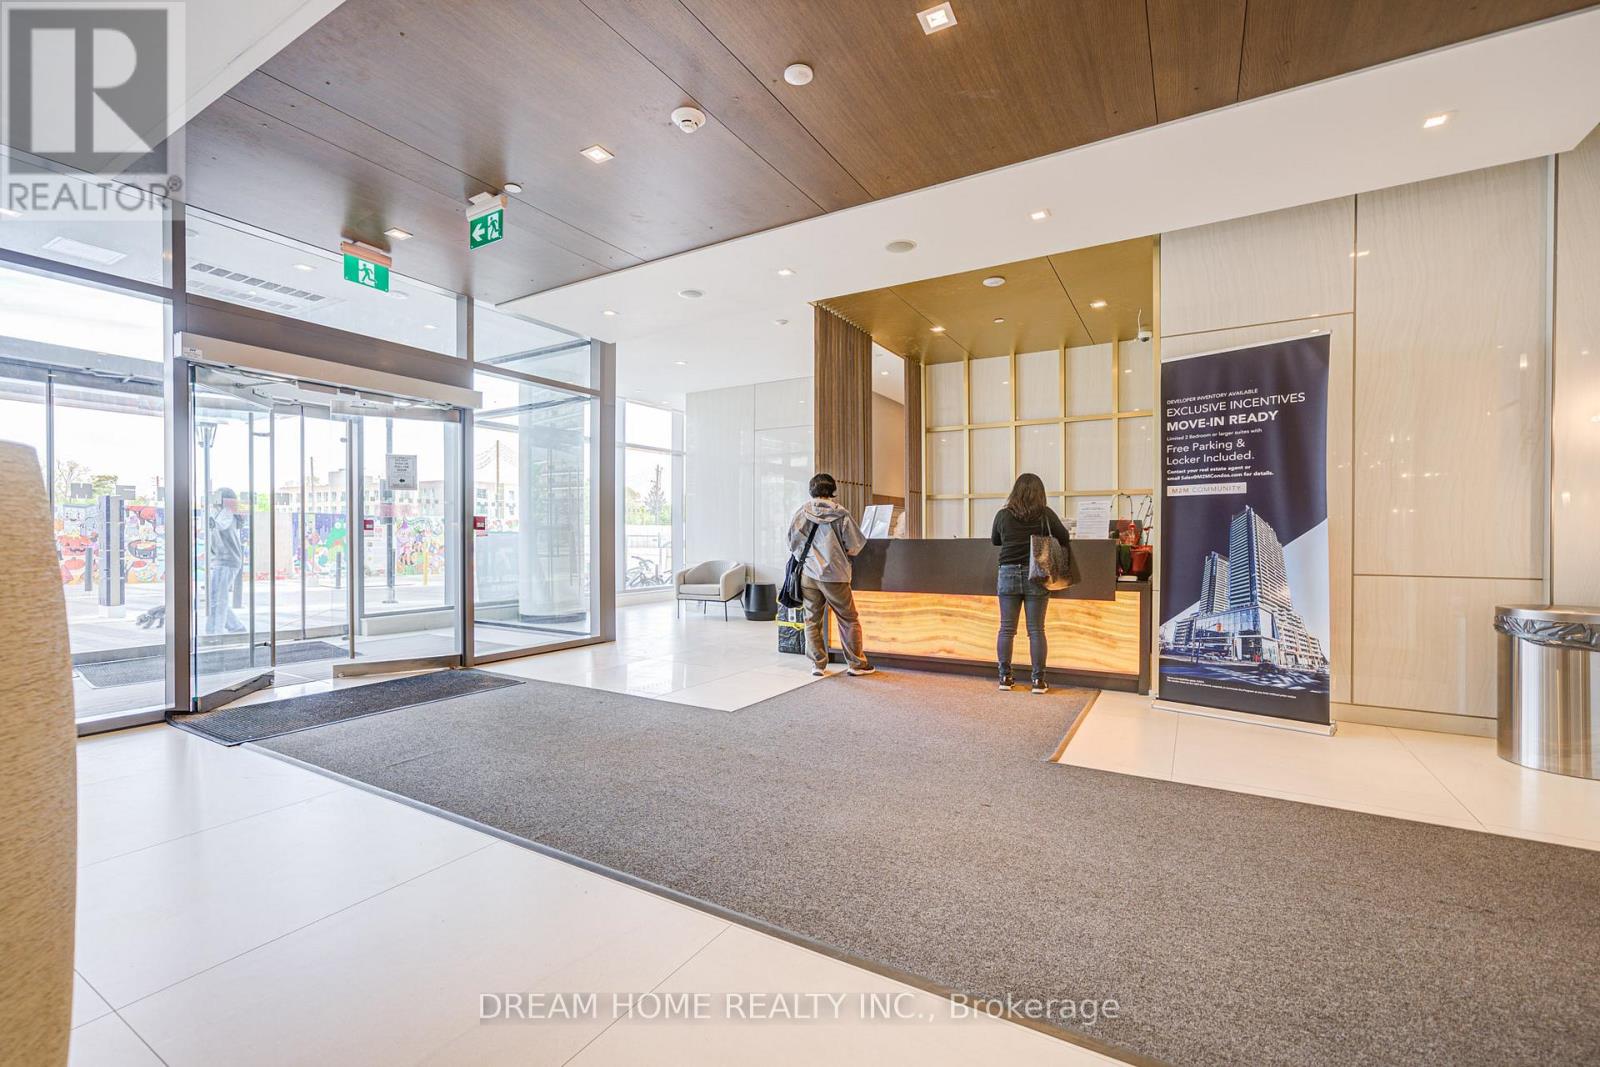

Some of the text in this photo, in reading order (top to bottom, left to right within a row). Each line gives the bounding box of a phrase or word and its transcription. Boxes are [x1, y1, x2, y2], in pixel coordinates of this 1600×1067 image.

[1166, 388, 1258, 405] DEVELOPER INVENTORY AVAILABLE
[1166, 392, 1306, 417] EXCLUSIVE INCENTIVES
[1166, 410, 1279, 432] MOVE-IN READY
[1189, 432, 1211, 440] Bedroom
[1166, 438, 1246, 454] Free Parking &
[1166, 450, 1255, 466] Locker Included.
[1191, 485, 1241, 494] COMMUNITY
